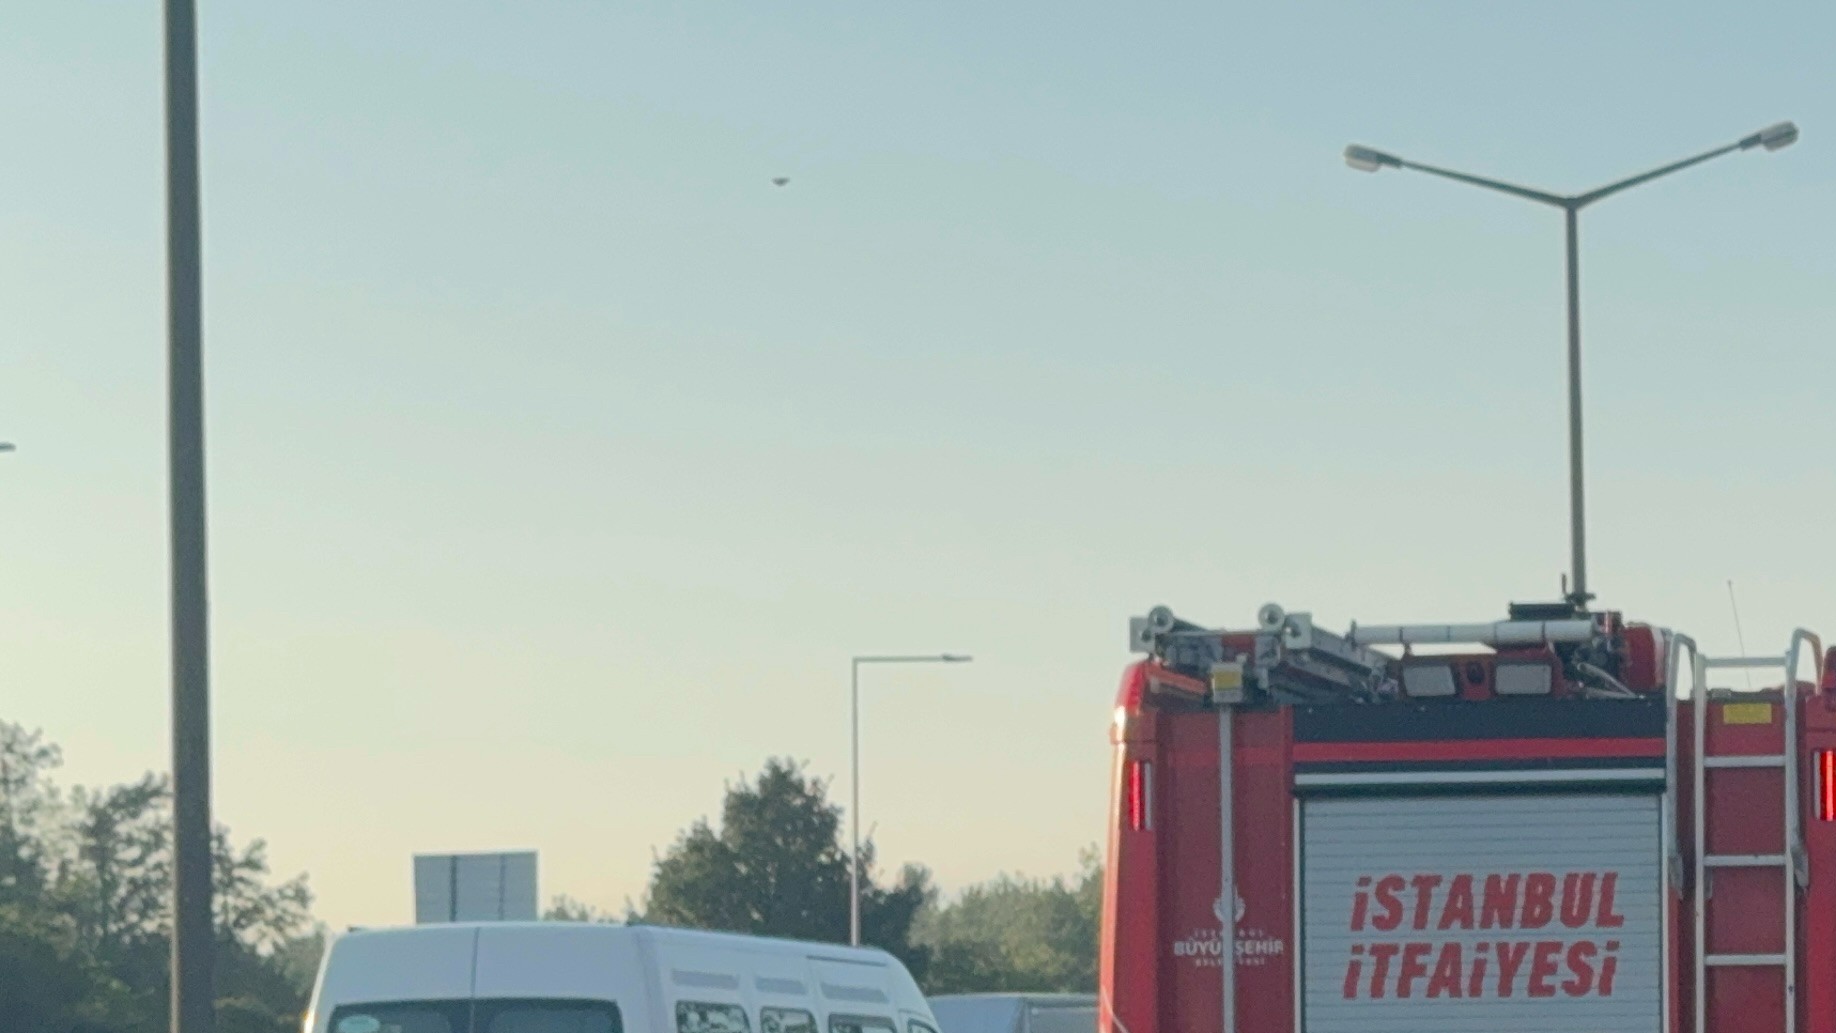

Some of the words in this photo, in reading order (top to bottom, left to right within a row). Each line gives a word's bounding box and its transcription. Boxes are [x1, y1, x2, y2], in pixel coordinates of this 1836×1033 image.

[1350, 871, 1625, 932] İSTANBUL
[1174, 936, 1284, 957] BÜYÜŞEHİR
[1342, 940, 1621, 999] İTFAİYESİ
